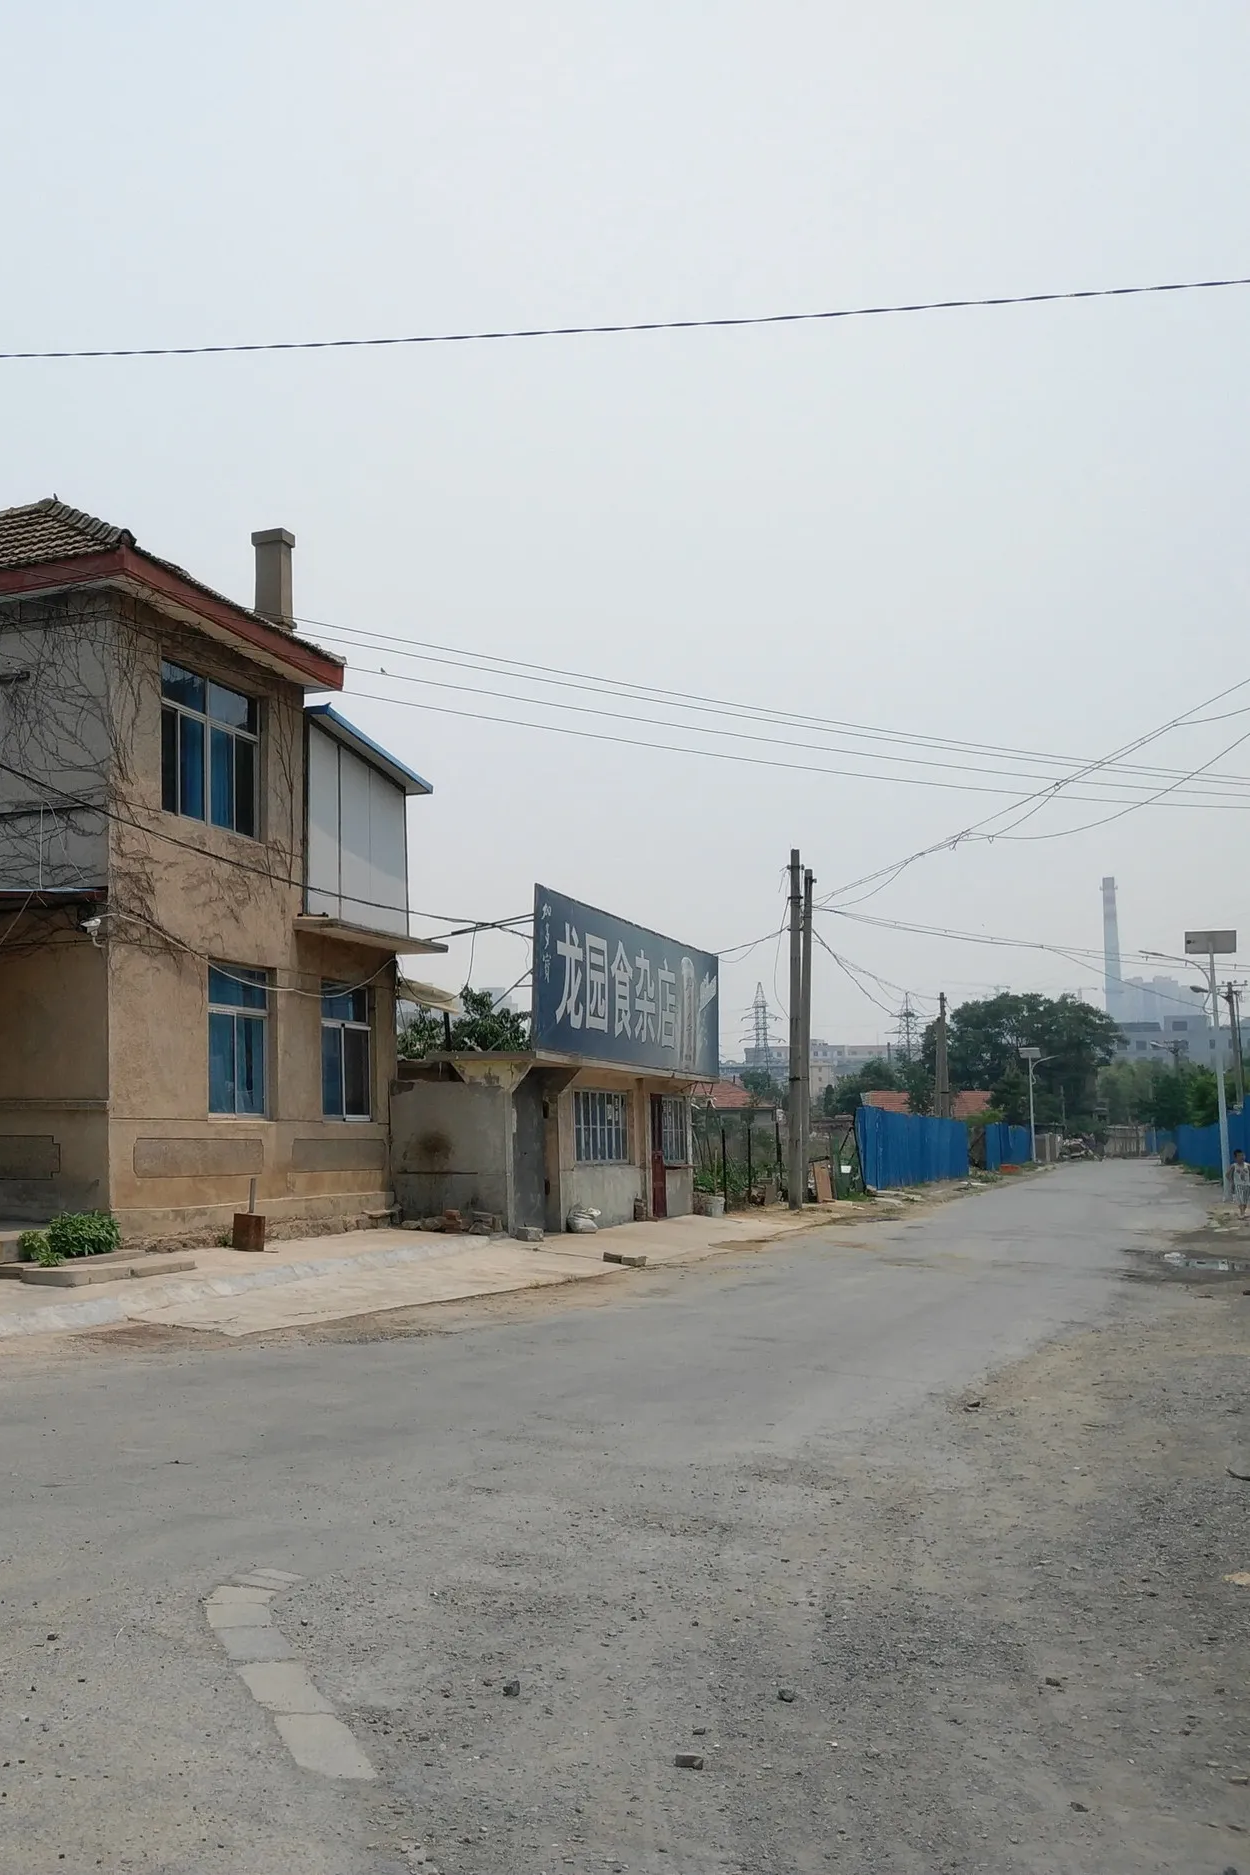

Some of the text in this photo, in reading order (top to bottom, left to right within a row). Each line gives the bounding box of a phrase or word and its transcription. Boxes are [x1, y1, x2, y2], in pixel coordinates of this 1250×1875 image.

[556, 922, 675, 1049] 龙园食杂店
